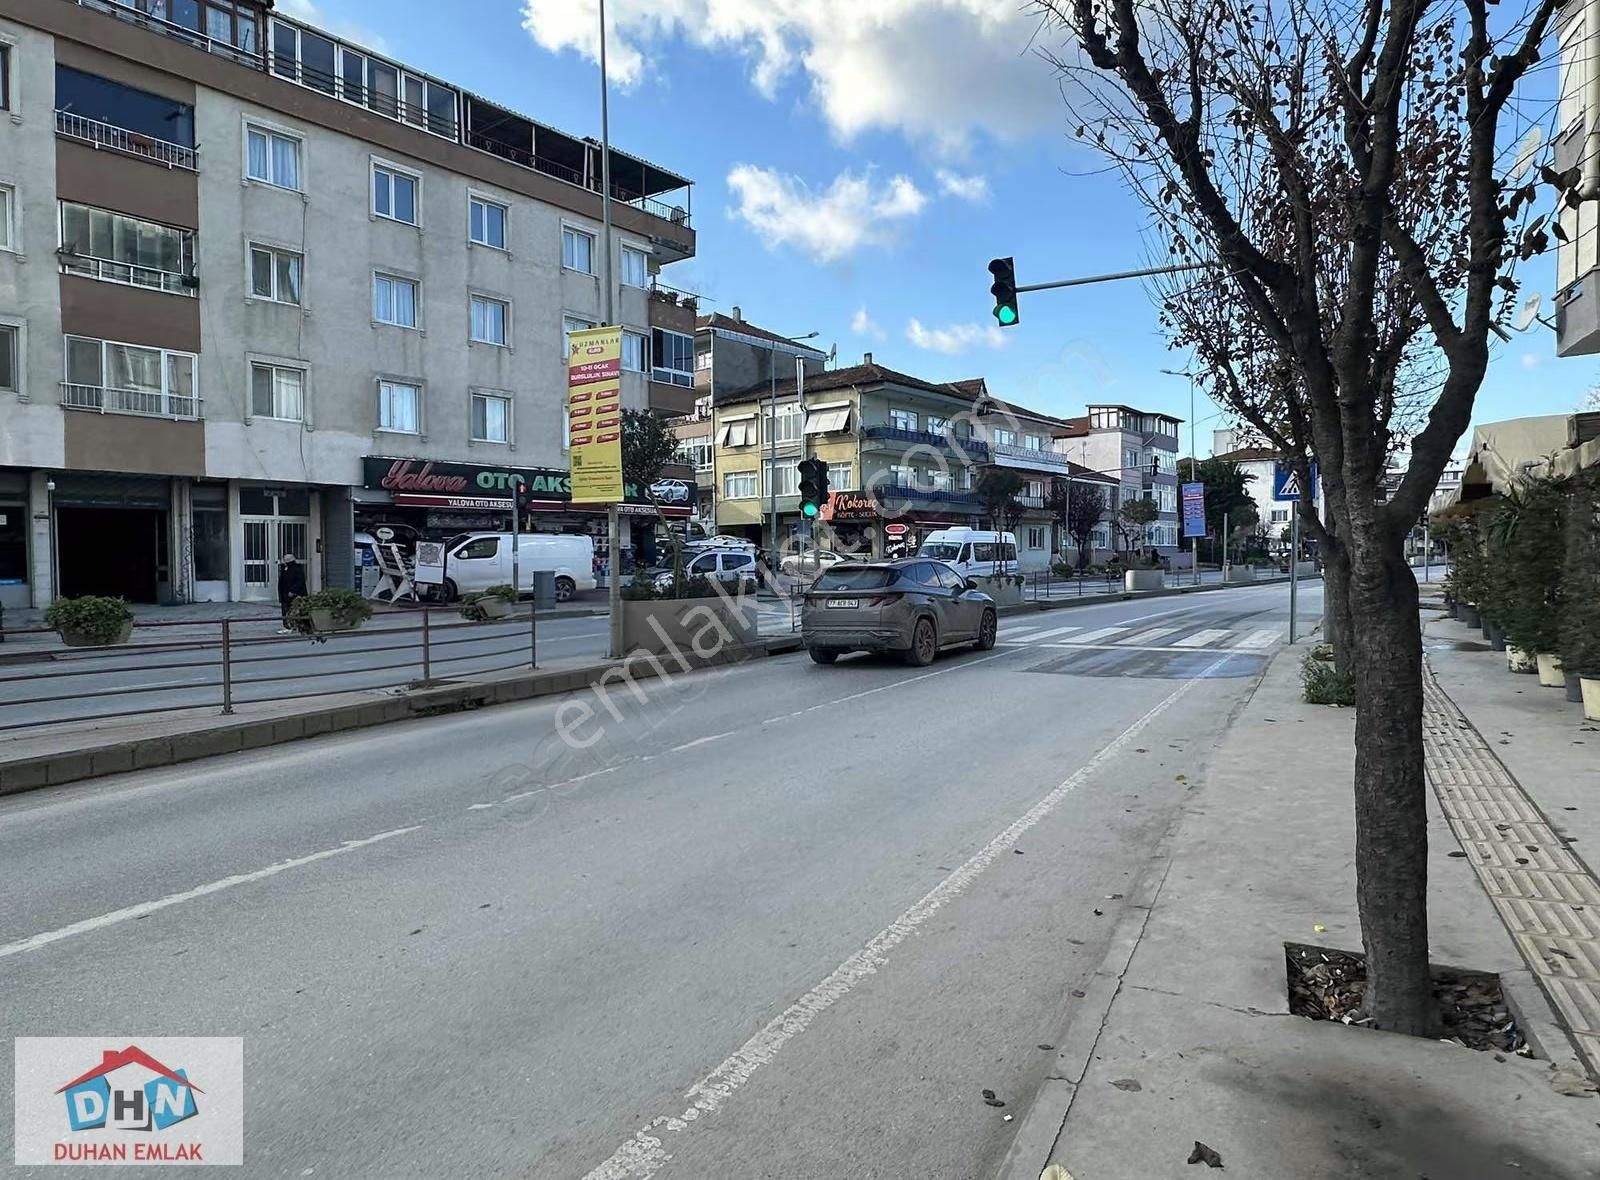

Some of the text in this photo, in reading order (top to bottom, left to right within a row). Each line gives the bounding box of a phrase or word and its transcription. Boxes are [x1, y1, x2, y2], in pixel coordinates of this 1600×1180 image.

[579, 338, 619, 347] UZMANLAR
[381, 460, 468, 492] Yalova
[447, 498, 475, 507] YALOVA
[835, 494, 879, 511] Kokoreç
